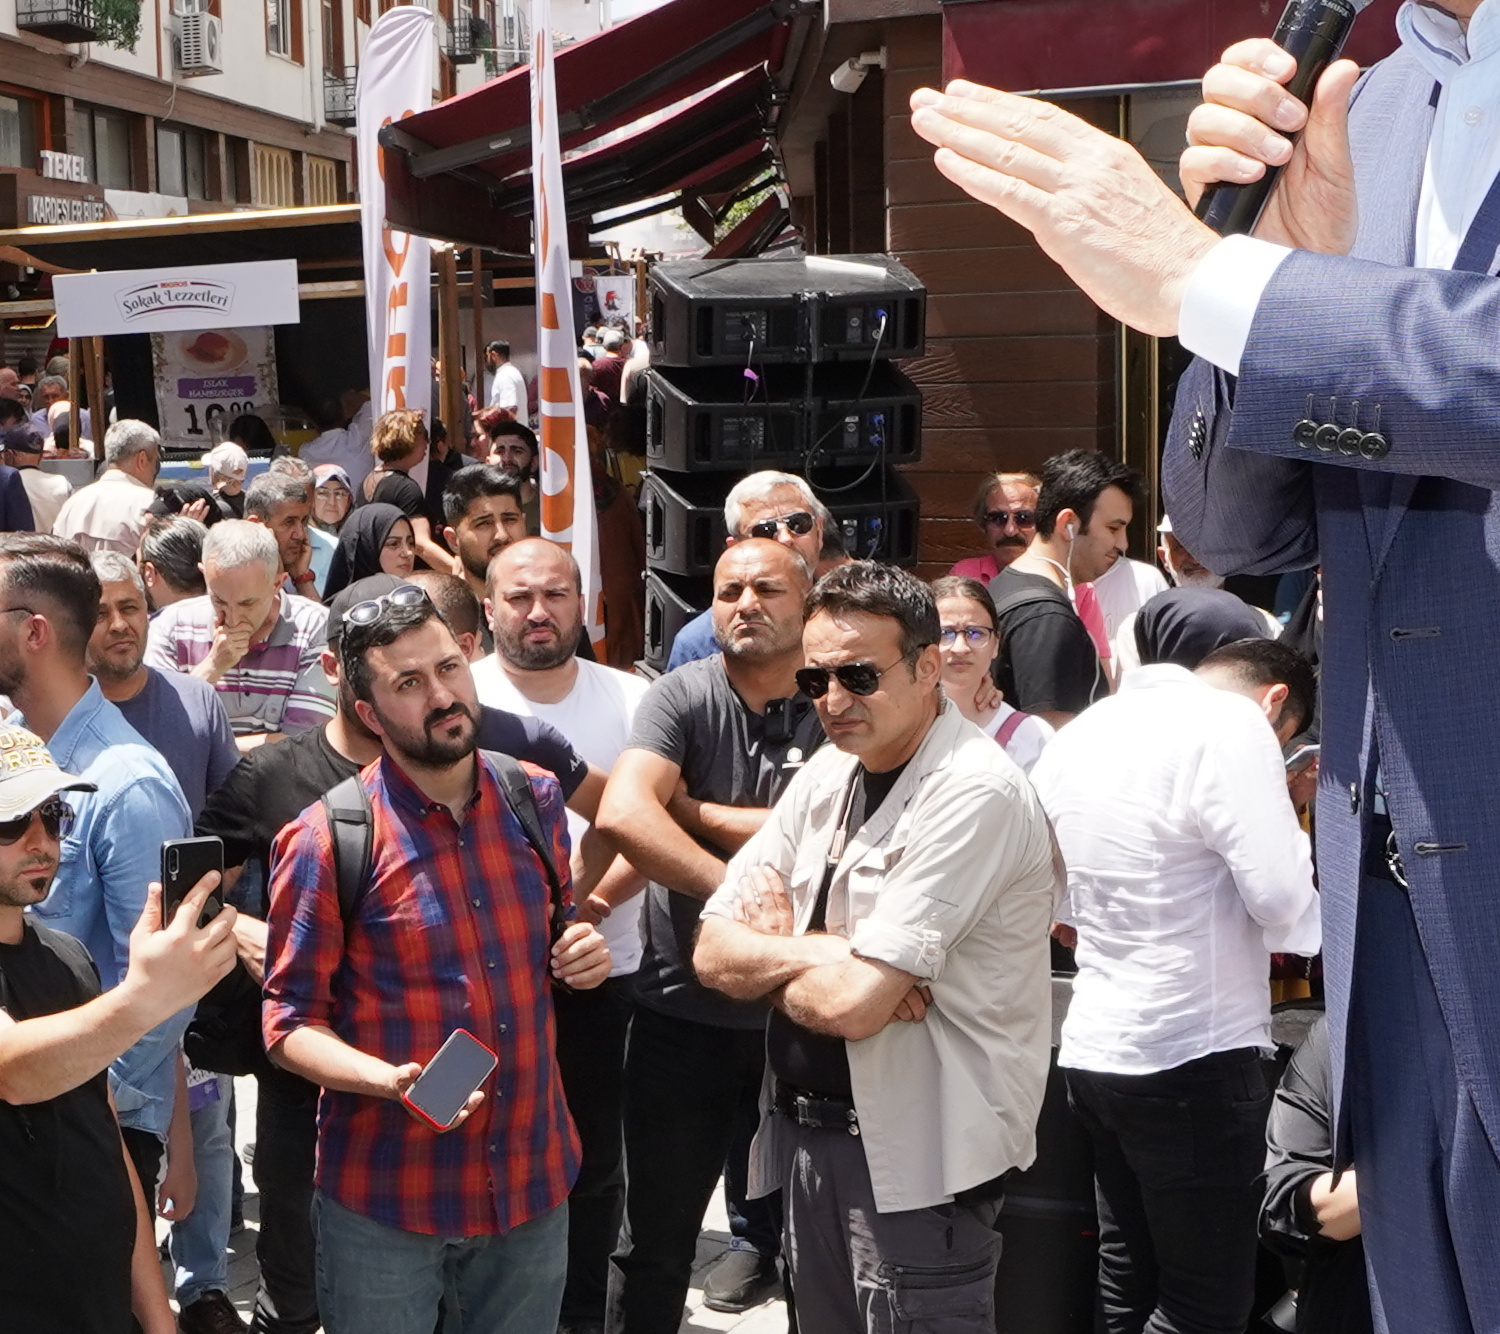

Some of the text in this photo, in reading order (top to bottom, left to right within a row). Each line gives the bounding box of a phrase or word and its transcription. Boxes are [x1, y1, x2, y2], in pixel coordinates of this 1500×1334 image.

[40, 150, 88, 183] TEKEL
[122, 289, 229, 315] Sokak Lezzetleri
[187, 387, 245, 398] HAMBURGER
